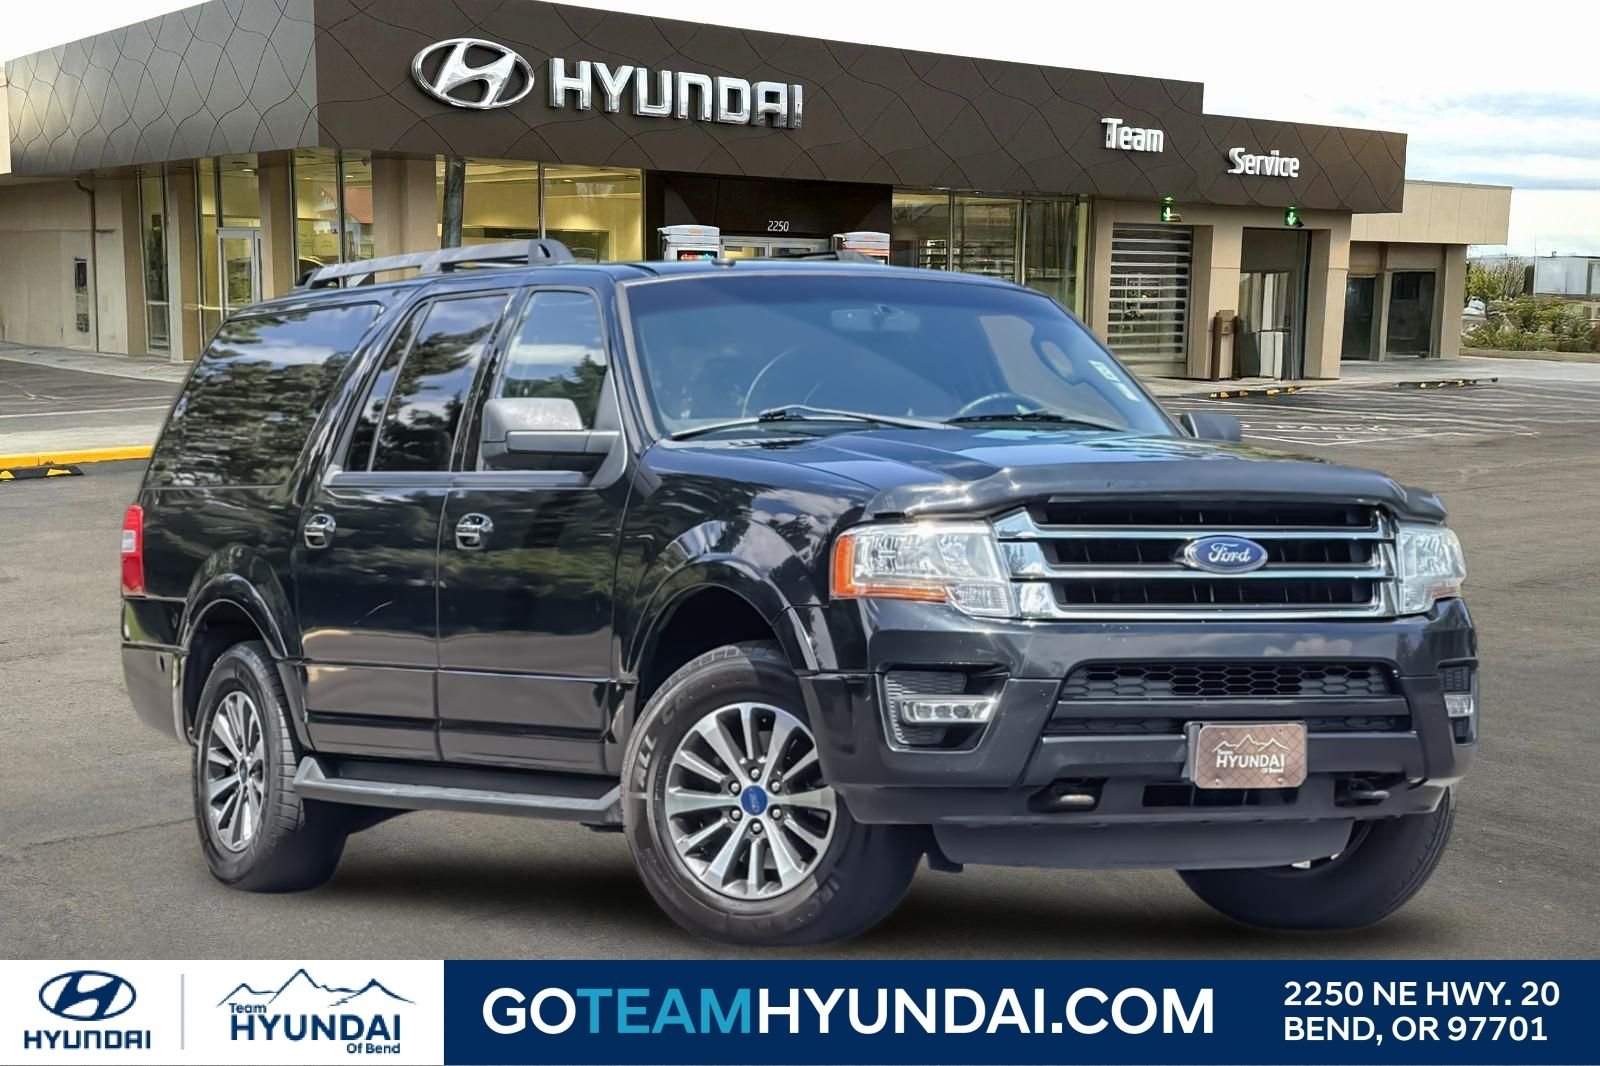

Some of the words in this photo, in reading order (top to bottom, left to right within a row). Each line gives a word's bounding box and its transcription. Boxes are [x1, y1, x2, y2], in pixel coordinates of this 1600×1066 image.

[549, 57, 803, 128] HYUNDAI
[1101, 117, 1164, 153] Team
[1227, 147, 1300, 178] Service
[767, 220, 790, 232] 2250
[1208, 542, 1251, 563] Ford
[1216, 754, 1284, 768] HYUNDAI
